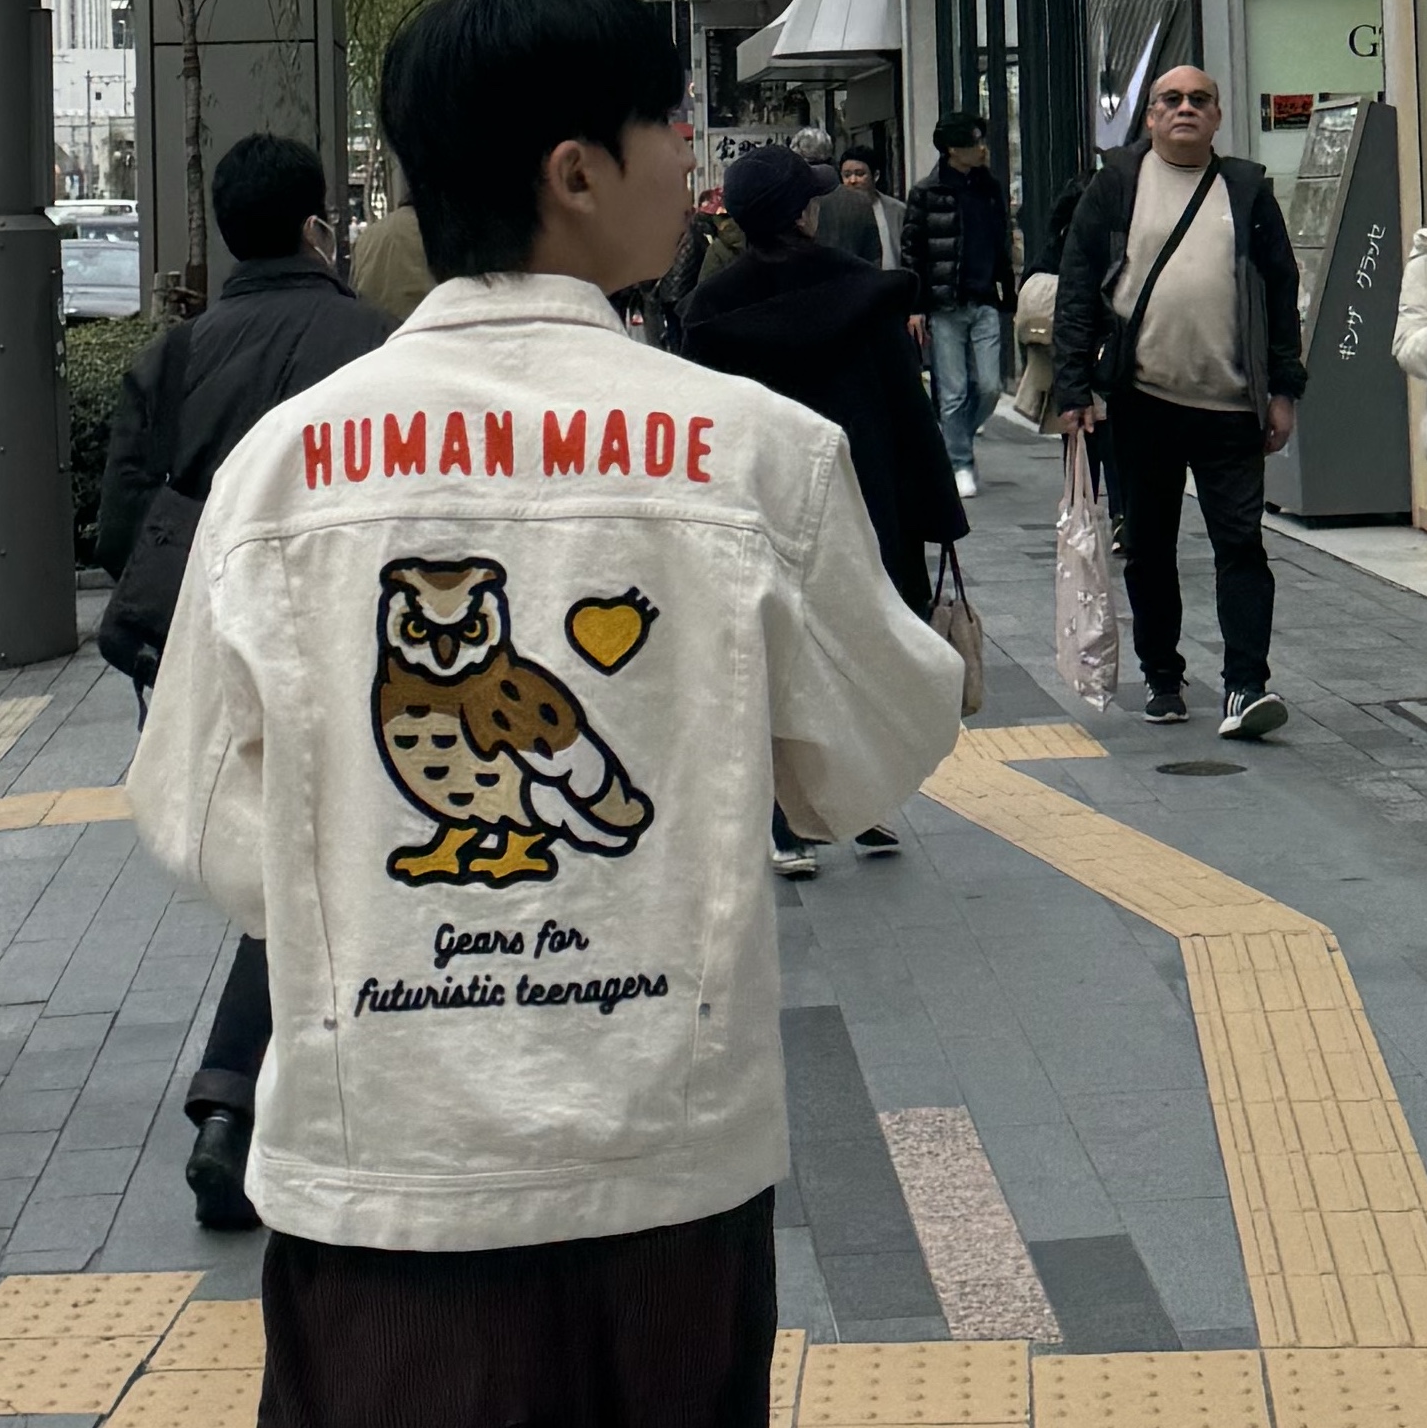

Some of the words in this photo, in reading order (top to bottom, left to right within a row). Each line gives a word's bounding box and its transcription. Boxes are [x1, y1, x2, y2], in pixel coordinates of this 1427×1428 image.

[1338, 305, 1364, 361] ギンザ
[1356, 224, 1386, 289] グラッセ
[302, 409, 514, 491] HUMAN
[541, 409, 715, 484] MADE
[433, 922, 525, 968] Gears
[533, 919, 590, 958] for
[353, 975, 506, 1017] futuristic
[516, 972, 670, 1015] teenagers
